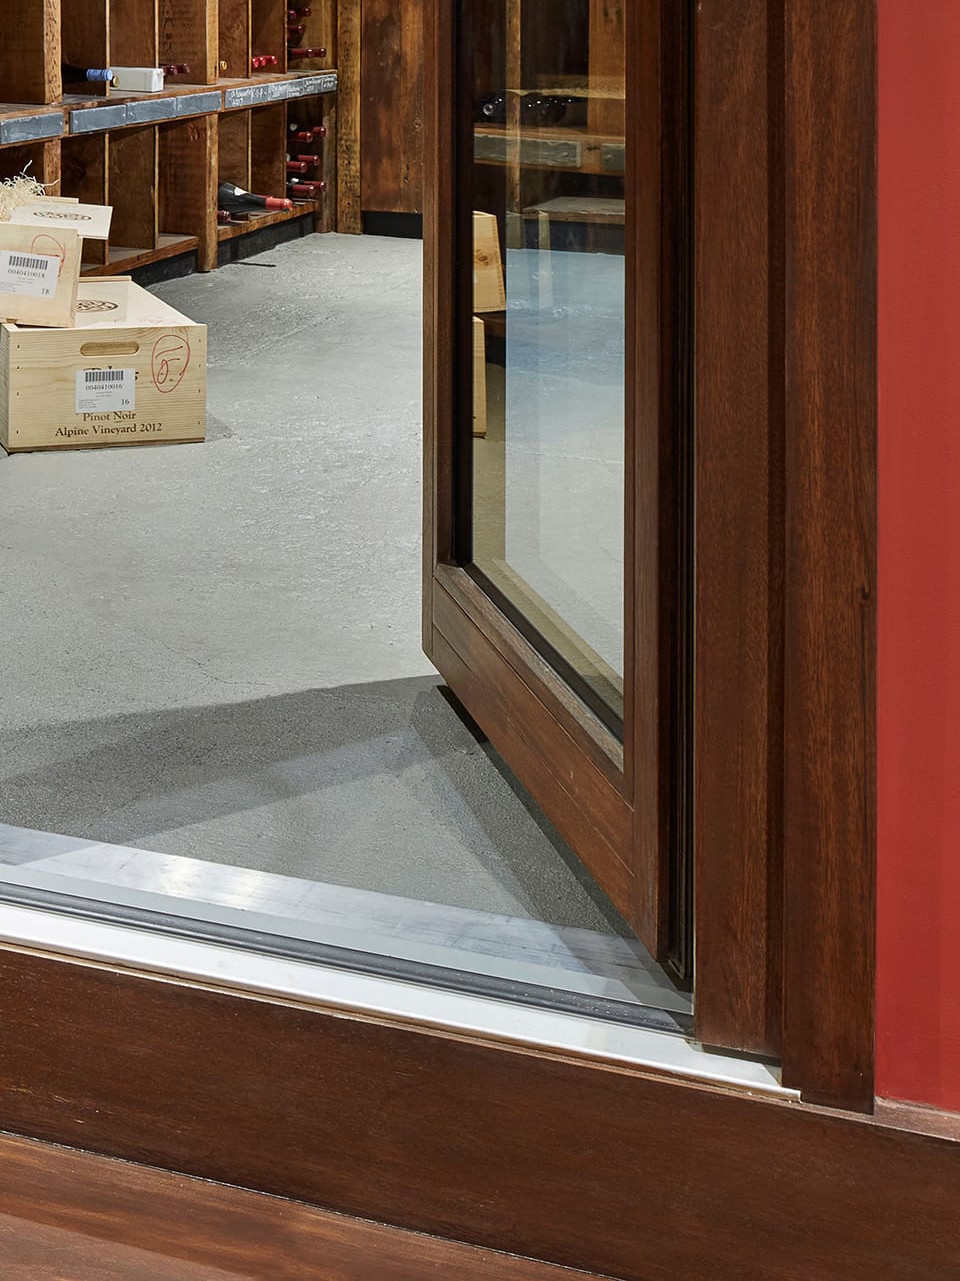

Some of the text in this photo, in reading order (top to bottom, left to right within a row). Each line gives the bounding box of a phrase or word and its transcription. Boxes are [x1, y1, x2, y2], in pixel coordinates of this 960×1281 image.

[41, 287, 50, 295] 18
[83, 410, 136, 422] Pinot Noir
[55, 422, 162, 437] Alpine Vineyard 2012
